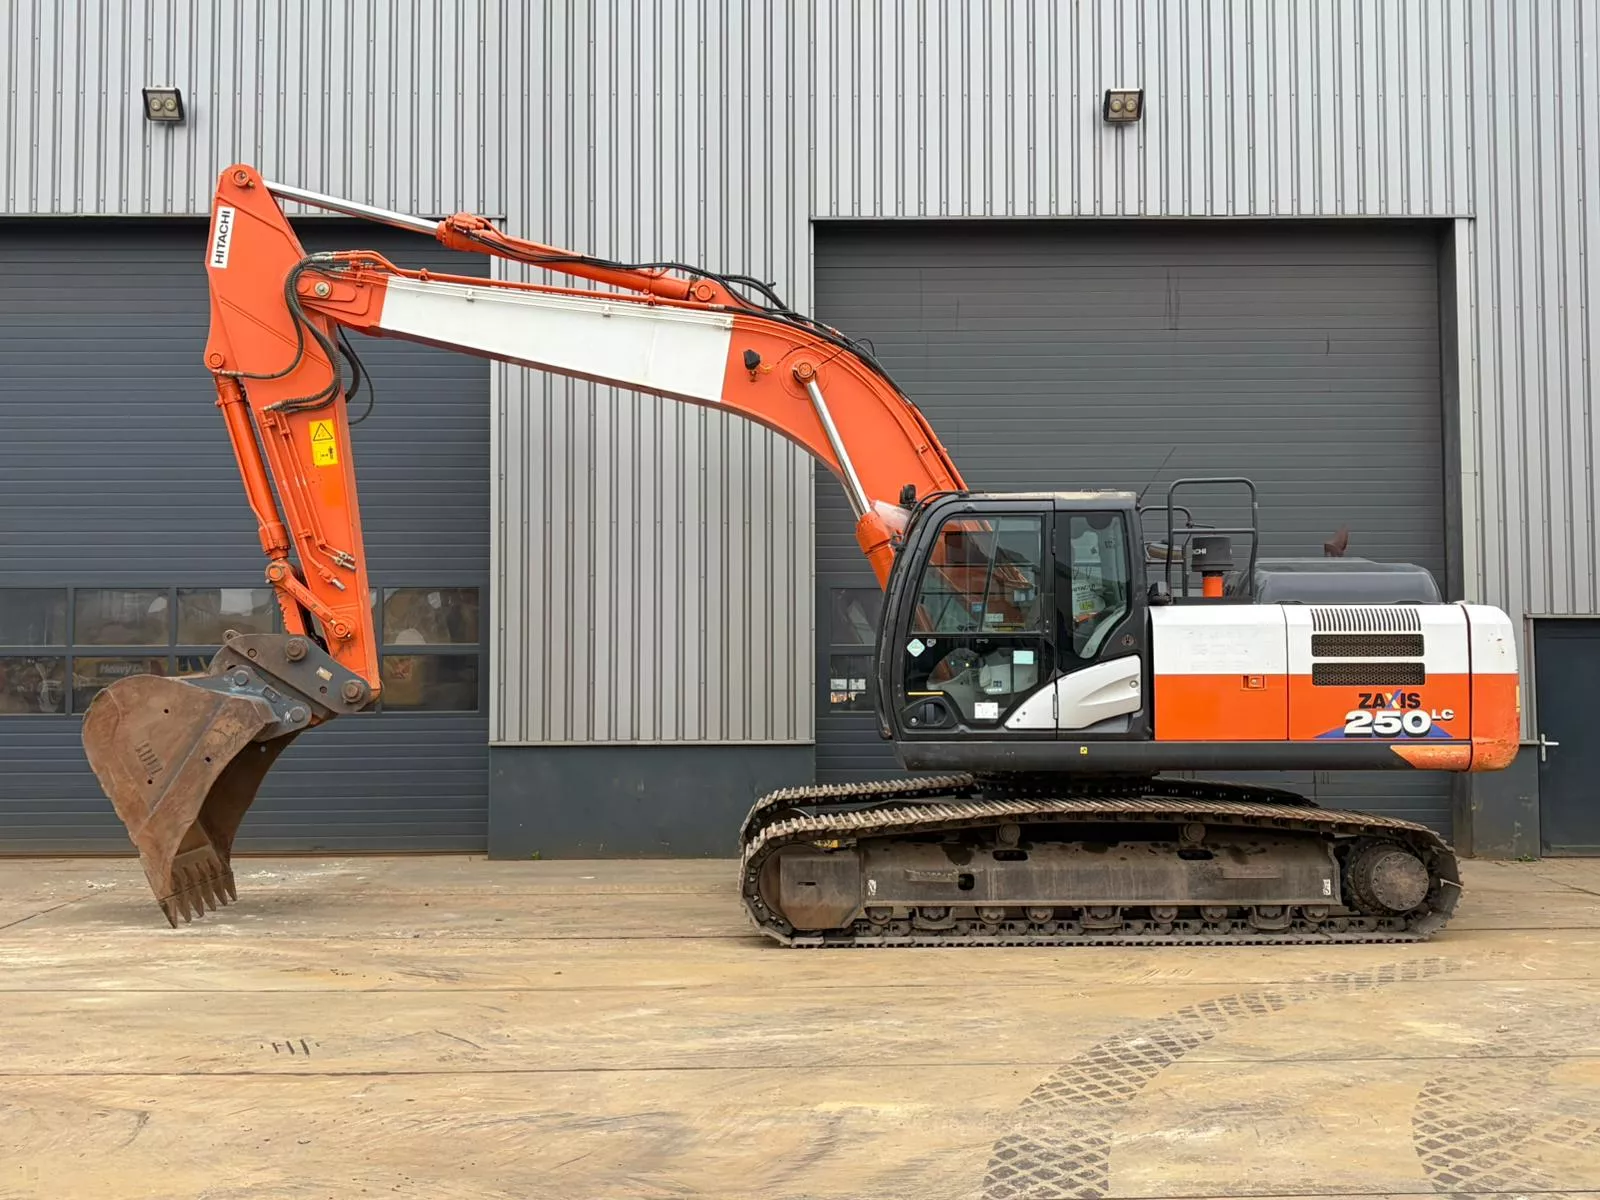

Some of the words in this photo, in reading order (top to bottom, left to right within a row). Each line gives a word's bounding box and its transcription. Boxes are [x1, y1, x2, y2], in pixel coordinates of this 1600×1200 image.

[214, 210, 231, 264] HITACHI
[1358, 690, 1421, 709] ZAXIS
[1344, 709, 1432, 737] 250
[1431, 709, 1454, 721] LC
